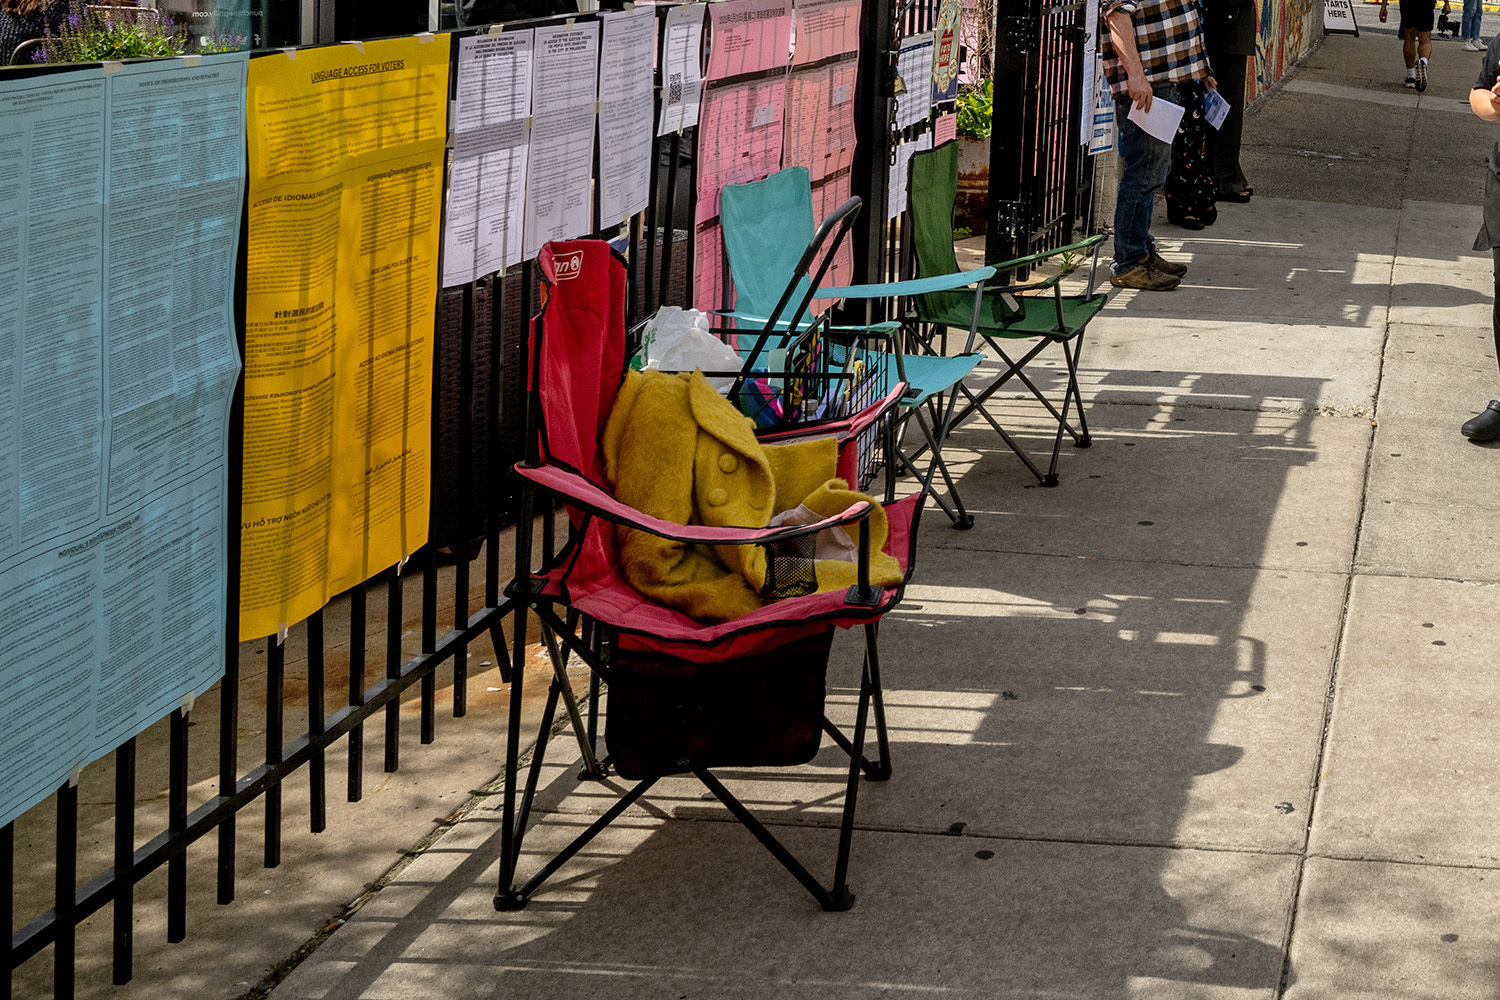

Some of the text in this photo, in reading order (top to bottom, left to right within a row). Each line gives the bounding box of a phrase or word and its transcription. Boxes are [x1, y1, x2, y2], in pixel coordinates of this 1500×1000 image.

[1328, 10, 1347, 18] HERE
[310, 59, 405, 82] LANGUAGE ACCESS FOR VOTERS
[284, 193, 316, 201] IDIOMAS
